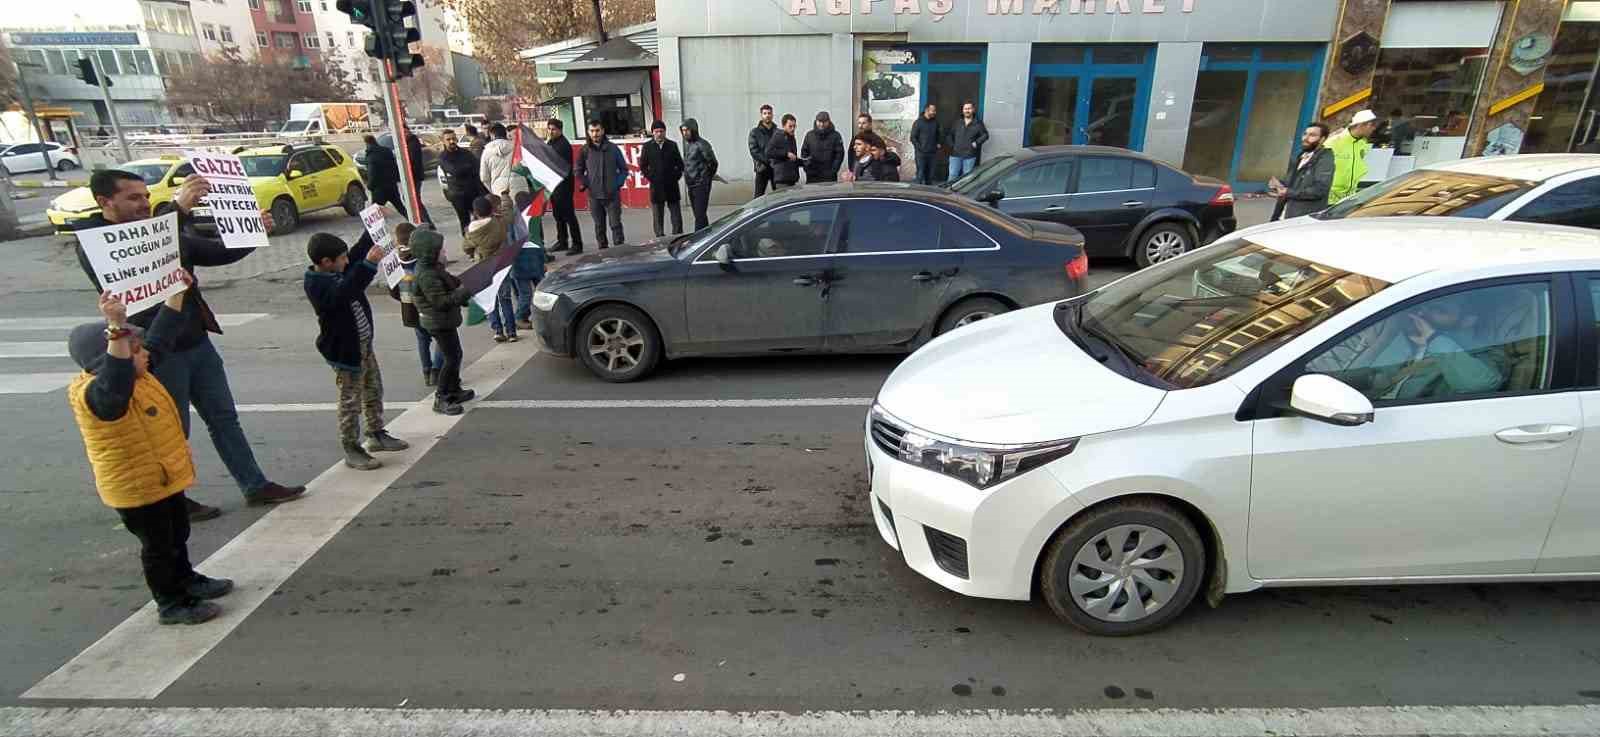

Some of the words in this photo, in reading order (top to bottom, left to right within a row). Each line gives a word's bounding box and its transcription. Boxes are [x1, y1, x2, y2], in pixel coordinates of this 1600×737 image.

[192, 157, 245, 176] GAZZE
[208, 183, 254, 195] ELEKTRİK
[211, 197, 258, 210] YİYECEK
[103, 225, 149, 244] DAHA
[152, 219, 169, 235] KAÇ
[216, 217, 235, 234] SU
[236, 217, 264, 233] YOK!
[109, 239, 160, 263] ÇOCUĞUN
[103, 266, 137, 284] ELİNE
[139, 265, 150, 275] ve
